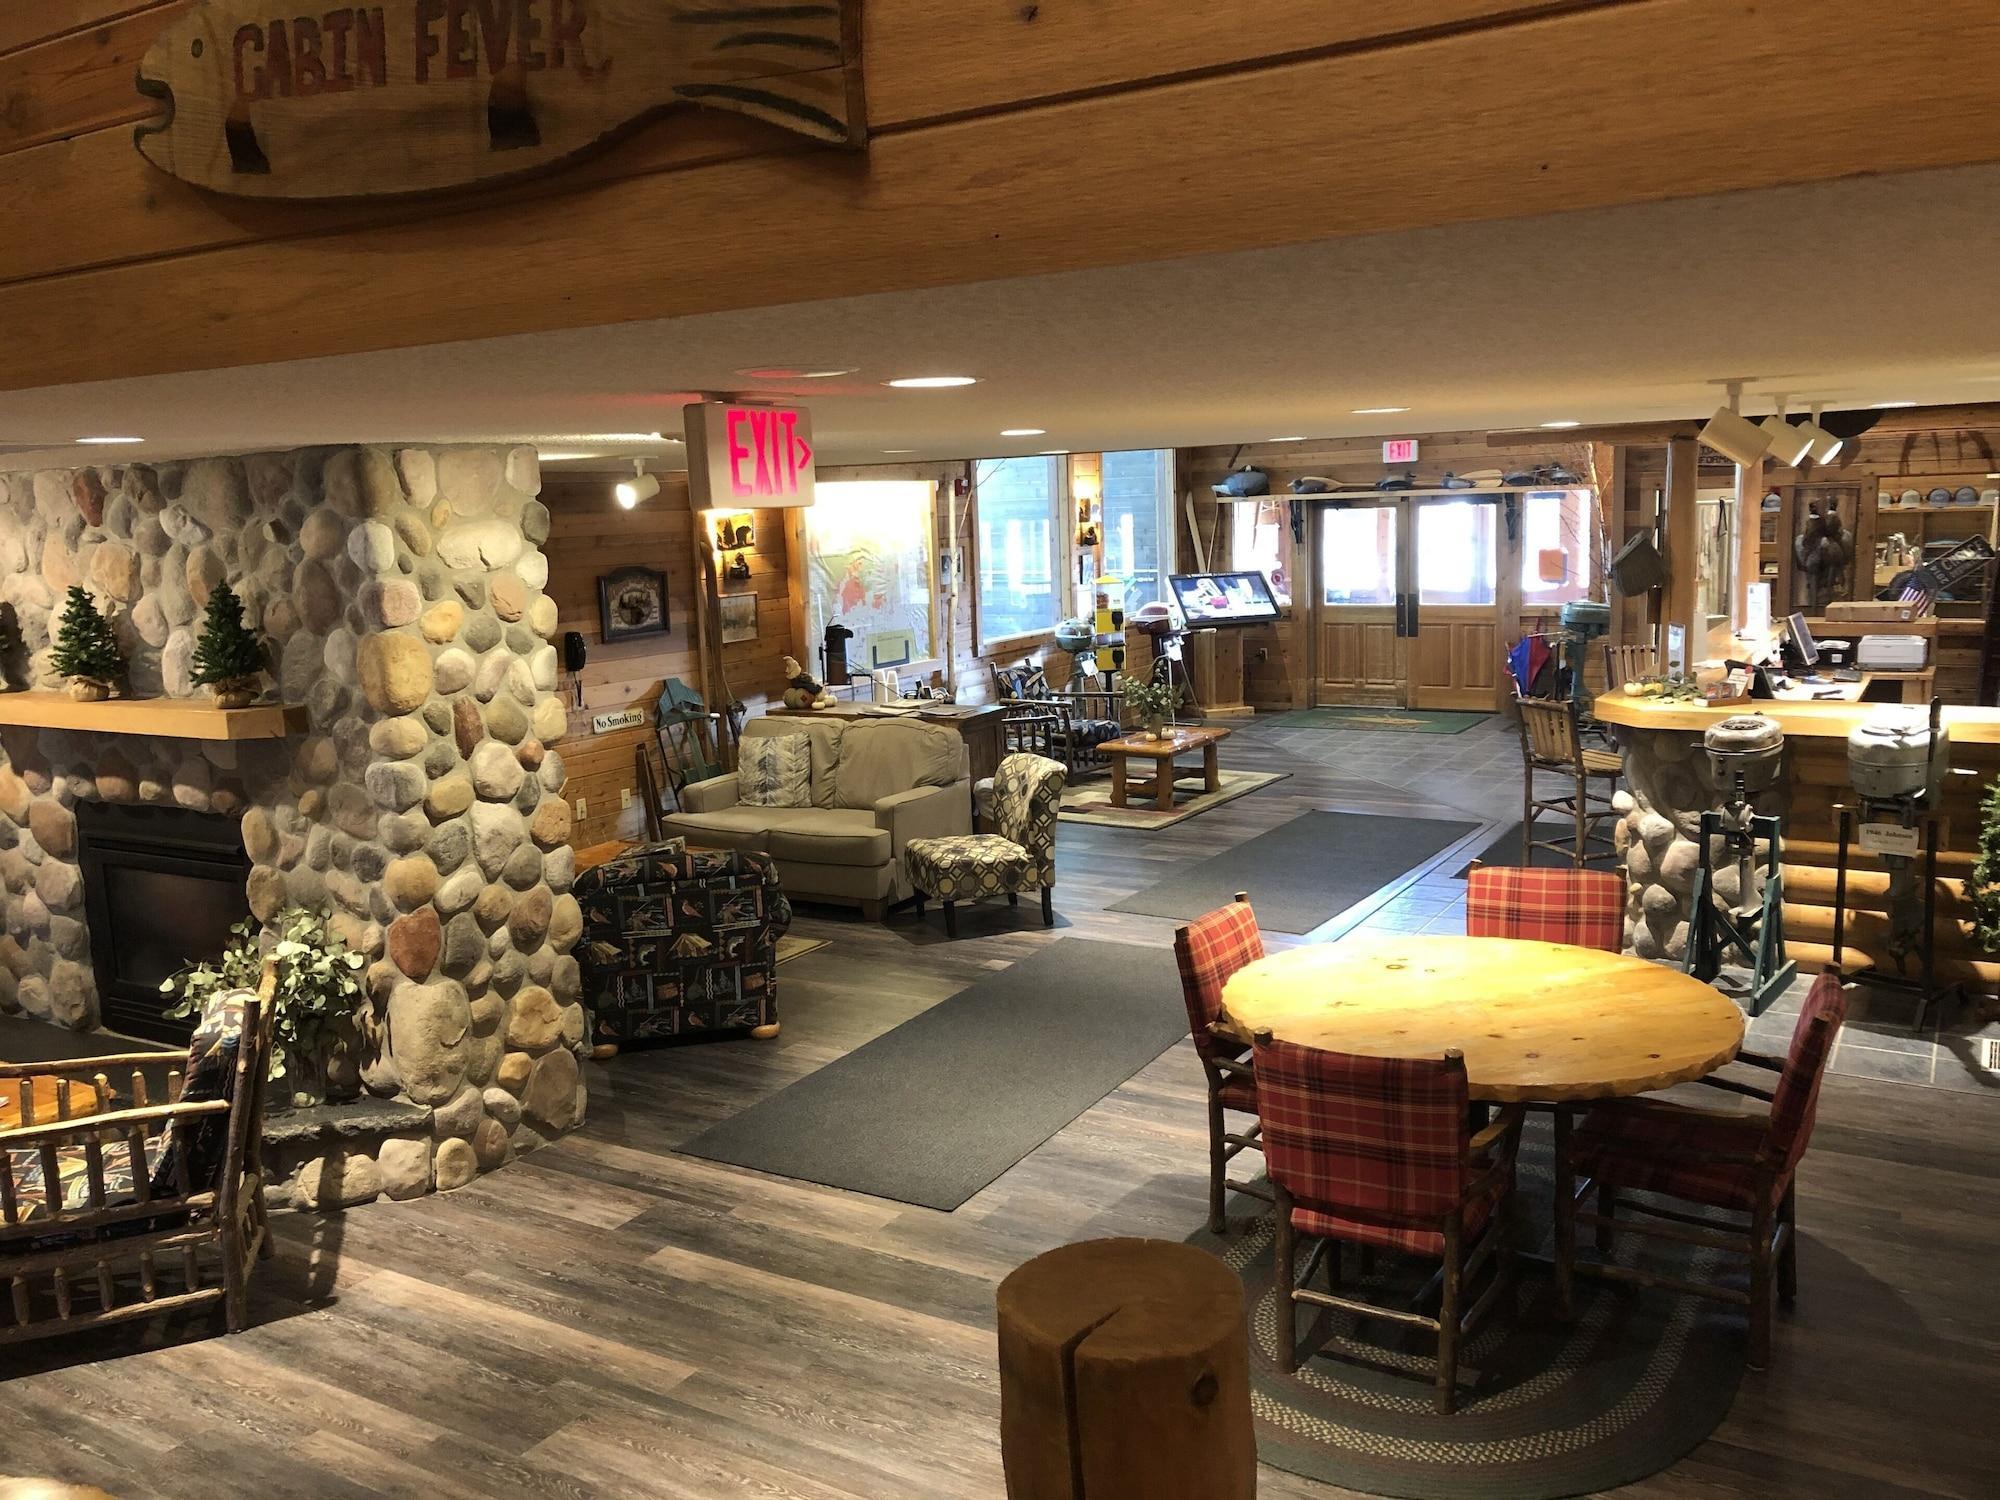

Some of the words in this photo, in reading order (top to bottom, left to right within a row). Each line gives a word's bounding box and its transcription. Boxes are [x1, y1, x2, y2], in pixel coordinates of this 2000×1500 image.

[233, 7, 387, 99] CABIN
[415, 0, 612, 85] FEVER
[726, 409, 798, 497] EXIT
[1389, 441, 1411, 459] EXIT
[595, 718, 607, 730] No
[607, 712, 642, 727] Smoking
